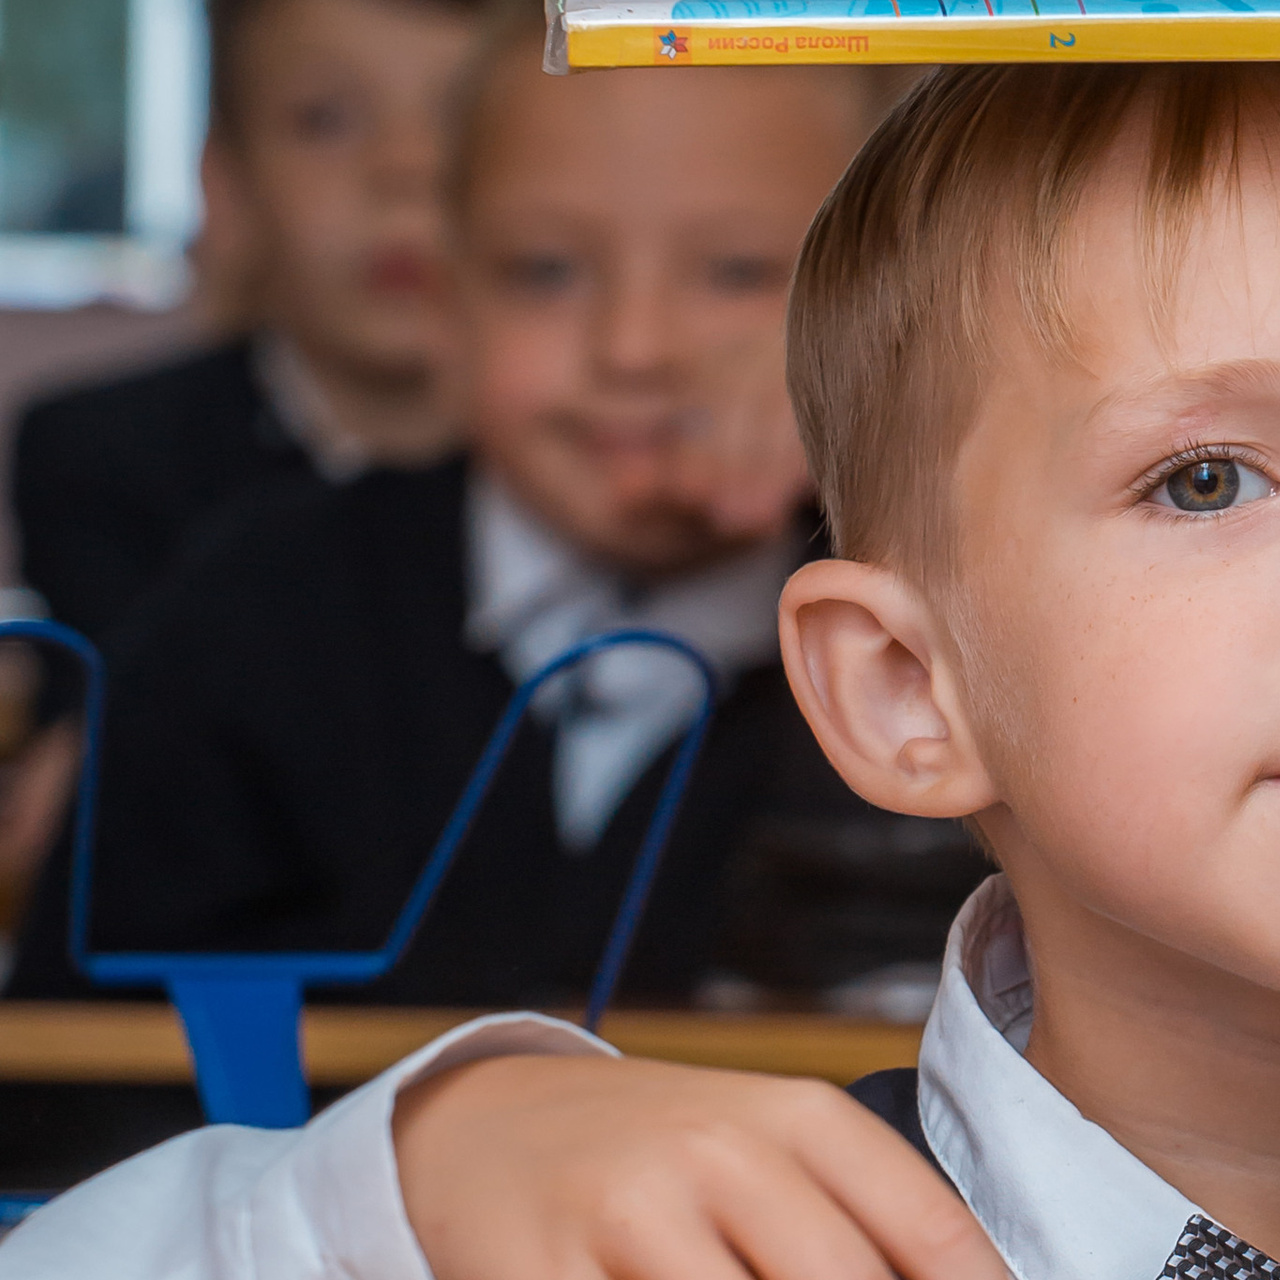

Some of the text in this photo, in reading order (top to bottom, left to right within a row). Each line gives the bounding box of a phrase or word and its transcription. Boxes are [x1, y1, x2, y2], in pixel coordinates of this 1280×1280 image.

[708, 35, 869, 54] Школа России
[1049, 31, 1076, 49] 2
